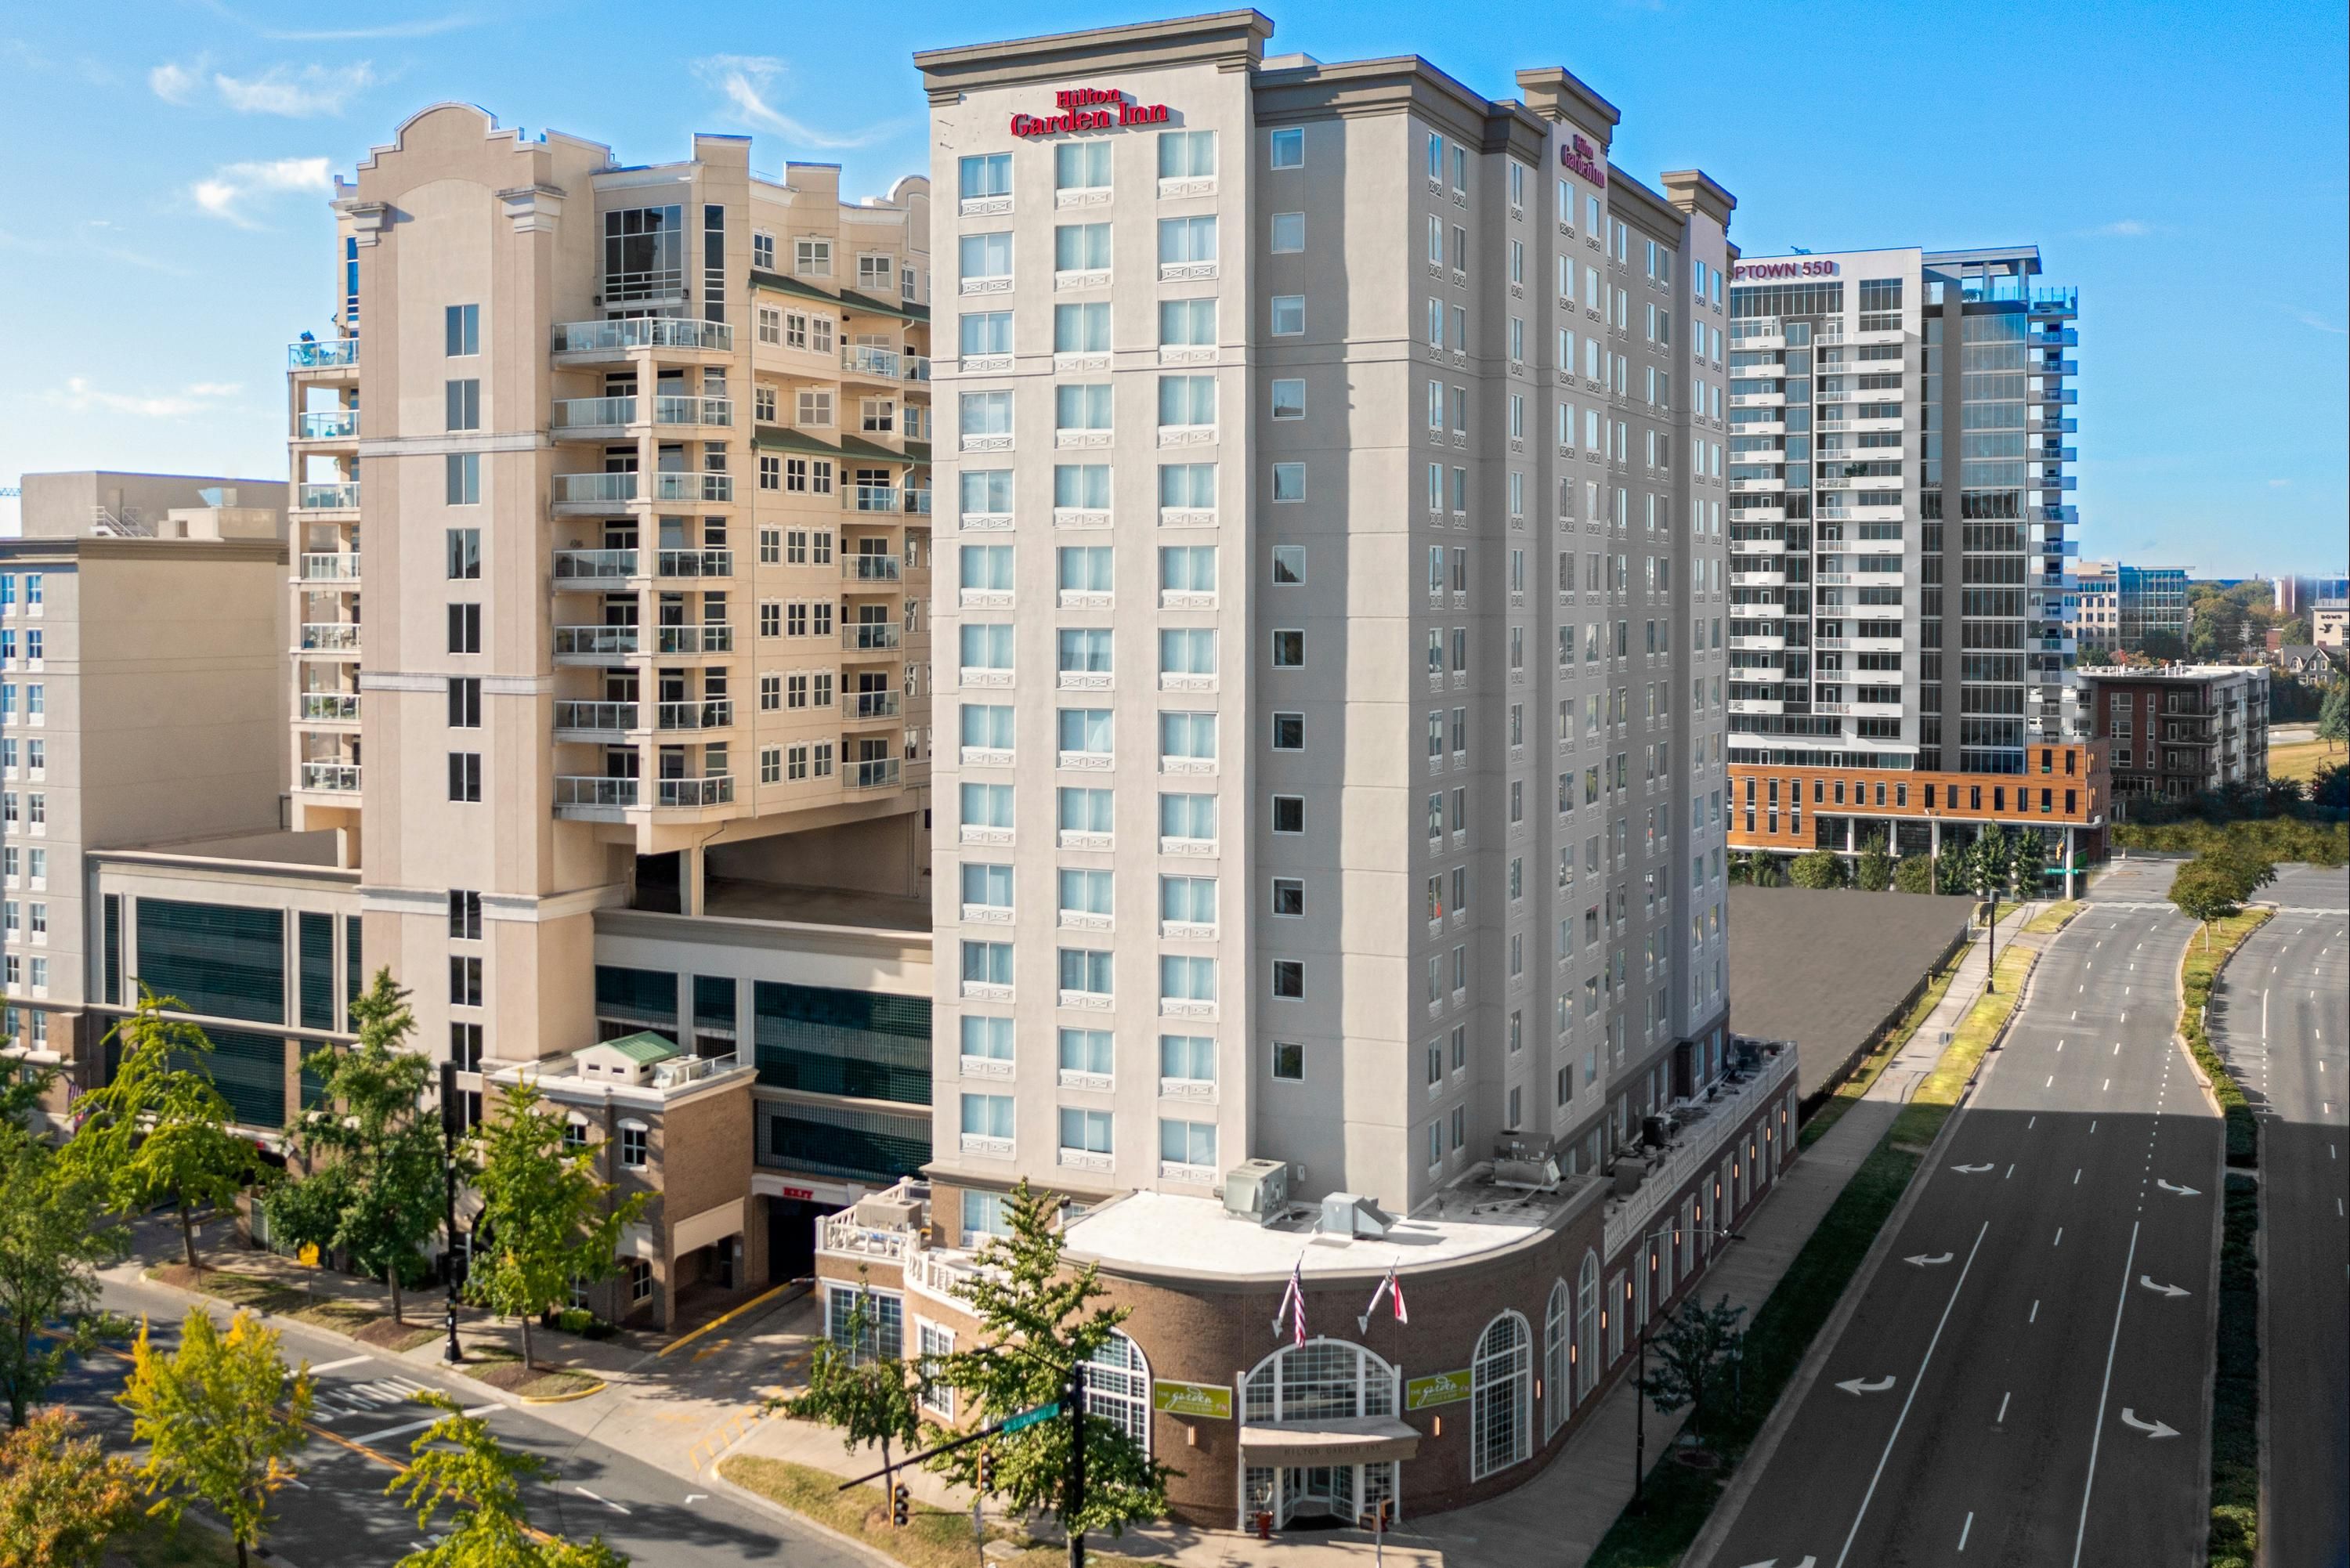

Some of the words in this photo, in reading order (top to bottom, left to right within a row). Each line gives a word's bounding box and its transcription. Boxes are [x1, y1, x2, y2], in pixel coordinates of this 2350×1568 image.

[1055, 87, 1122, 108] Hilton
[1010, 108, 1112, 137] Garden
[1117, 102, 1169, 126] Inn
[1560, 144, 1593, 182] Garden
[1732, 262, 1796, 280] PTOWN
[1802, 260, 1833, 276] 550
[1285, 1446, 1320, 1456] HILTON
[1326, 1444, 1361, 1455] GARDEN
[1366, 1443, 1381, 1454] INN
